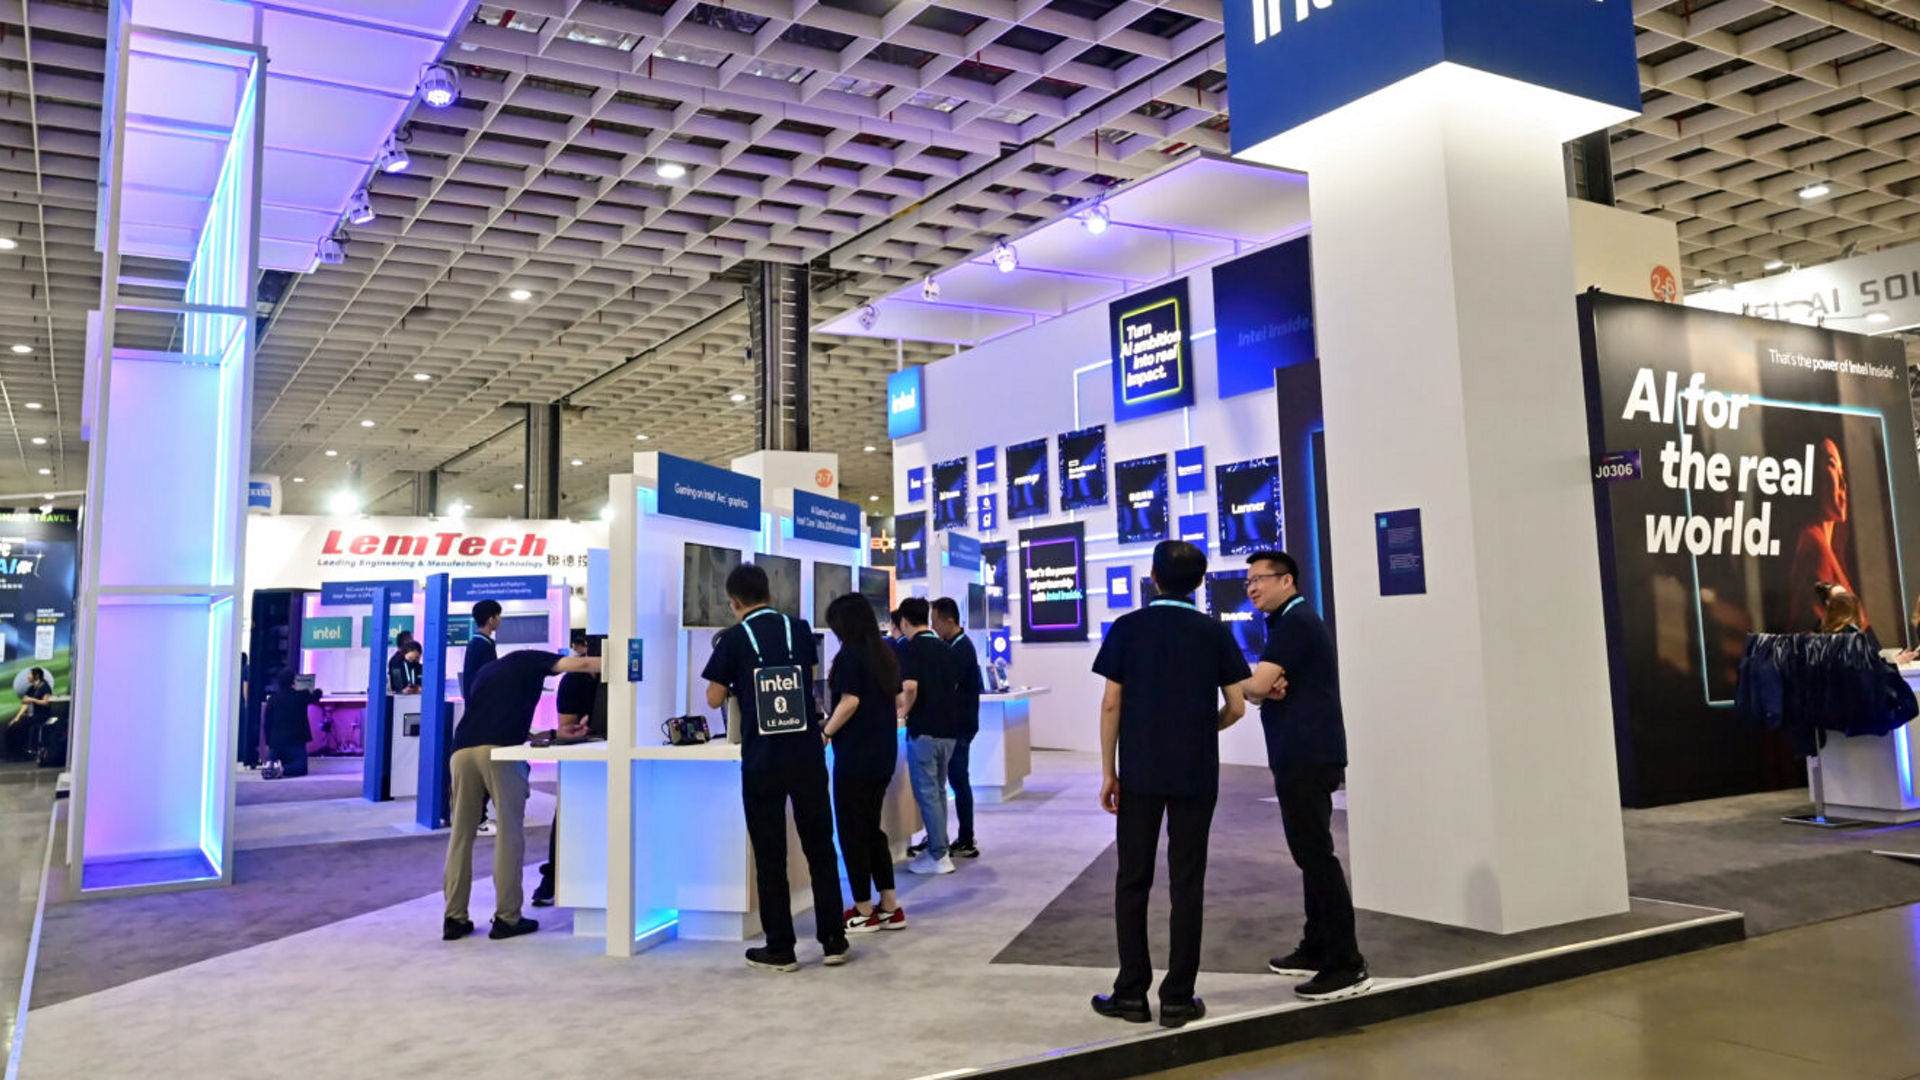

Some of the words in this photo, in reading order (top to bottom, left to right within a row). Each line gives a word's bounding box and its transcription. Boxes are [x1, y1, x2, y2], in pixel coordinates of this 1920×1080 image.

[1126, 322, 1152, 340] Turn
[1238, 328, 1266, 347] Intel
[1120, 342, 1133, 358] AI
[1133, 329, 1182, 355] ambition
[1134, 353, 1155, 369] into
[1155, 344, 1178, 364] real
[1768, 349, 1796, 366] That's
[1797, 353, 1812, 368] the
[1813, 358, 1838, 372] power
[1840, 359, 1848, 372] of
[1849, 360, 1868, 375] Intel
[1127, 364, 1167, 388] impact.
[892, 387, 915, 414] intel
[1622, 367, 1677, 424] AI
[1684, 371, 1750, 430] for
[1595, 462, 1633, 479] J0306
[1660, 434, 1731, 492] the
[1738, 444, 1815, 496] real
[35, 514, 72, 522] TRAVEL
[1231, 501, 1266, 515] Lanner
[1646, 501, 1780, 556] world.
[321, 530, 547, 556] LemTech
[317, 560, 356, 568] Leading
[359, 560, 415, 569] Engineering
[427, 560, 492, 569] Manufacturing
[495, 560, 543, 569] Technology
[313, 625, 341, 640] intel
[760, 672, 798, 692] intel
[778, 717, 801, 726] Audio
